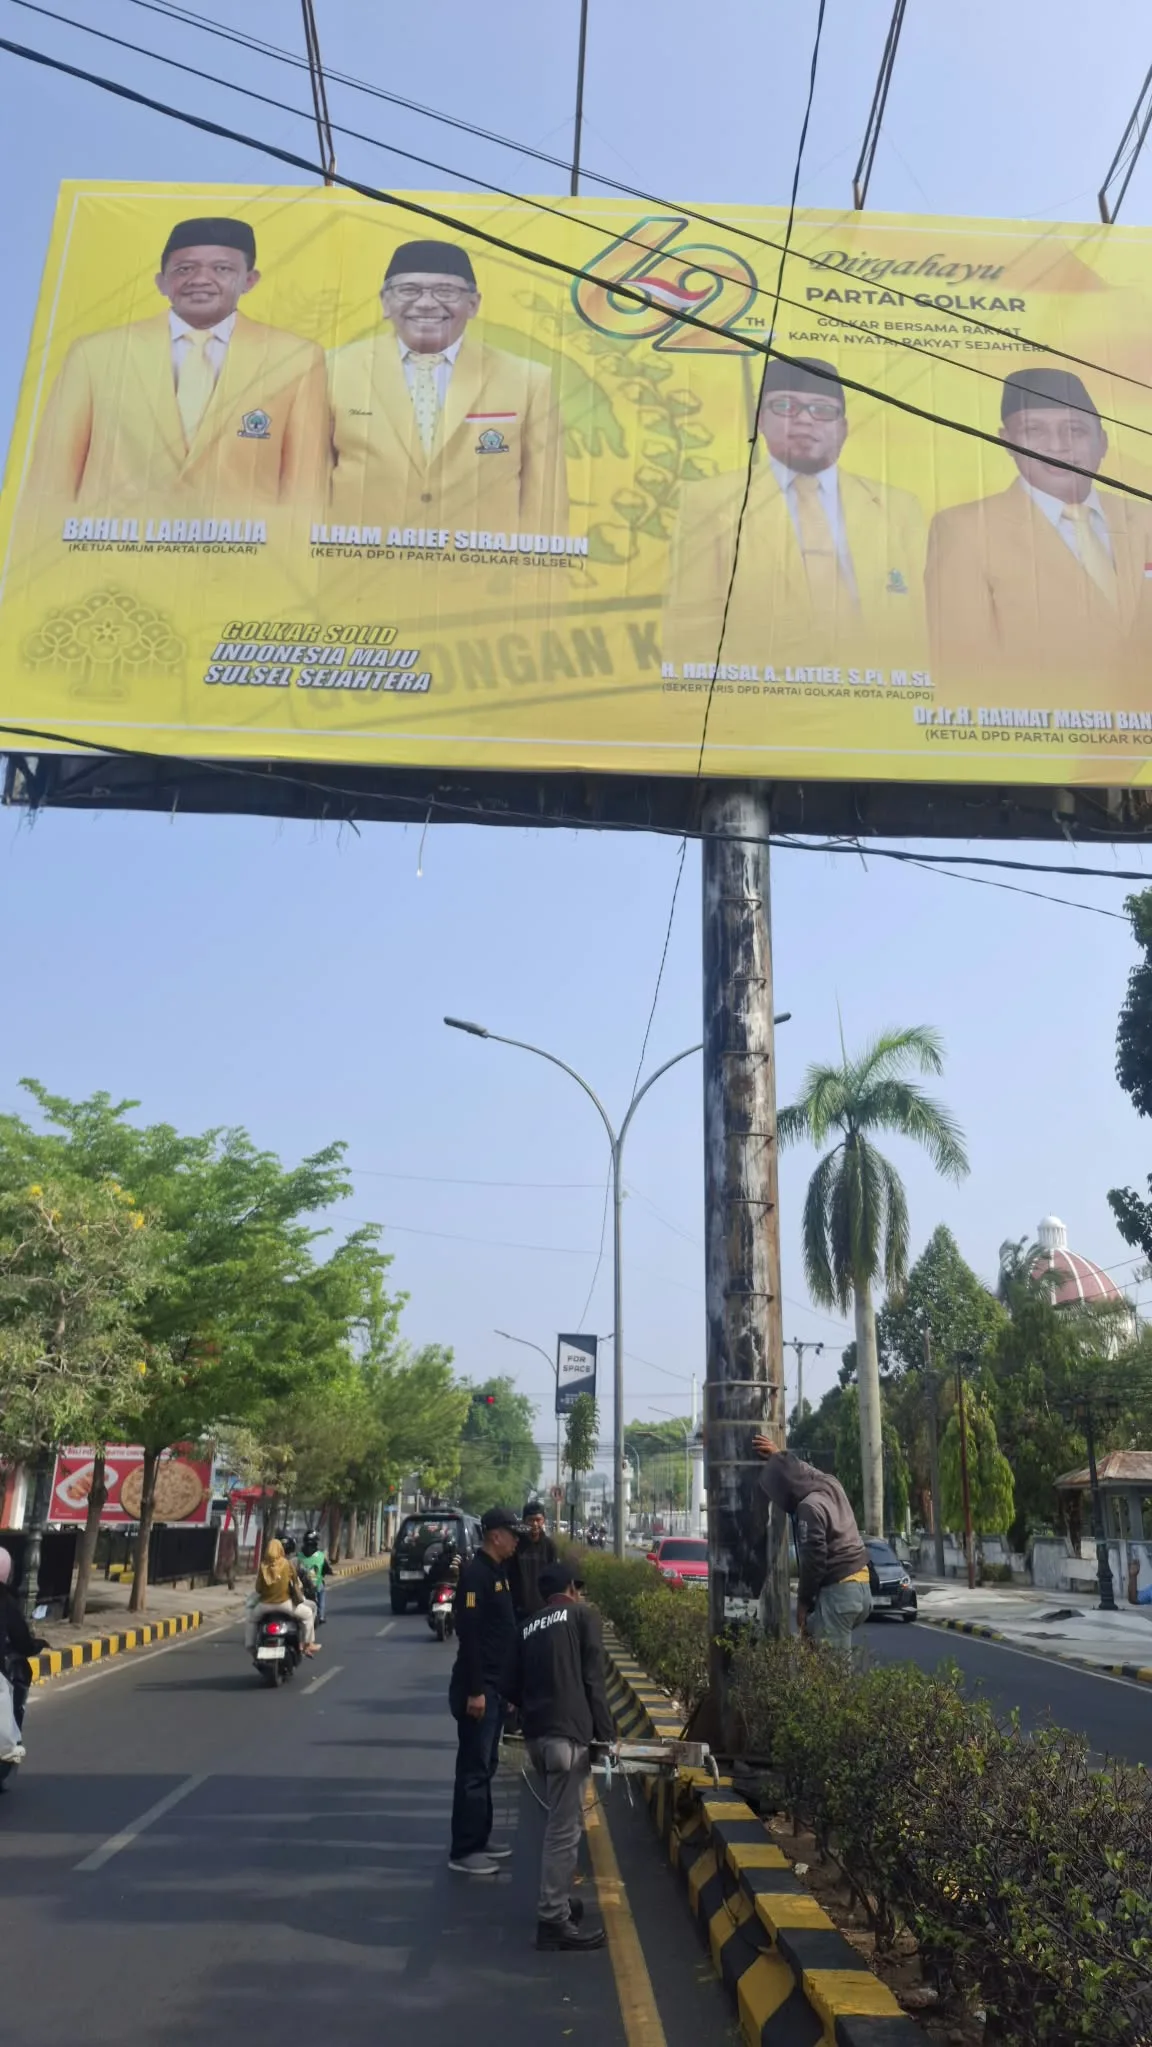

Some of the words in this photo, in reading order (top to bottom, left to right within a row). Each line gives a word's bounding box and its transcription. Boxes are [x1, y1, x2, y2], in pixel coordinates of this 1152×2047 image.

[808, 250, 1005, 286] Dirgahayu
[805, 287, 906, 307] PARTAI
[914, 293, 1026, 313] GOLKAR
[745, 317, 765, 327] TH
[817, 317, 880, 331] GOLKAR
[884, 321, 959, 335] BERSAMA
[788, 331, 840, 344] KARYA
[902, 337, 961, 349] RAKYAT
[63, 517, 139, 542] BAHLIL
[145, 518, 267, 545] LAHADALIA
[310, 523, 382, 547] ILHAM
[386, 526, 450, 550] ARIEF
[454, 529, 589, 557] SIRAJUDDIN
[68, 543, 114, 553] (KETUA
[117, 543, 151, 553] UMUM
[157, 544, 200, 554] PARTAI
[203, 545, 257, 556] GOLKAR)
[311, 547, 363, 559] (KETUA
[367, 549, 395, 560] DPD
[408, 551, 455, 562] PARTAI
[460, 553, 519, 566] GOLKAR
[221, 619, 322, 645] GOLKAR
[323, 623, 399, 647] SOLID
[210, 641, 345, 667] INDONESIA
[348, 645, 421, 670] MAJU
[204, 663, 293, 688] SULSEL
[296, 667, 432, 694] SEJAHTERA
[661, 662, 679, 681] H.
[763, 665, 782, 683] A.
[661, 682, 734, 695] (SEKERTARIS
[737, 684, 760, 695] DPD
[763, 685, 801, 697] PARTAI
[804, 687, 850, 698] GOLKAR
[853, 688, 883, 699] KOTA
[886, 689, 935, 702] PALOPO)
[977, 706, 1051, 729] RAHMAT
[1053, 708, 1115, 731] MASRI
[925, 728, 977, 741] (KETUA
[981, 730, 1011, 742] DPD
[1014, 731, 1064, 743] PARTAI
[1068, 732, 1129, 745] GOLKAR
[562, 1364, 592, 1373] SPACE
